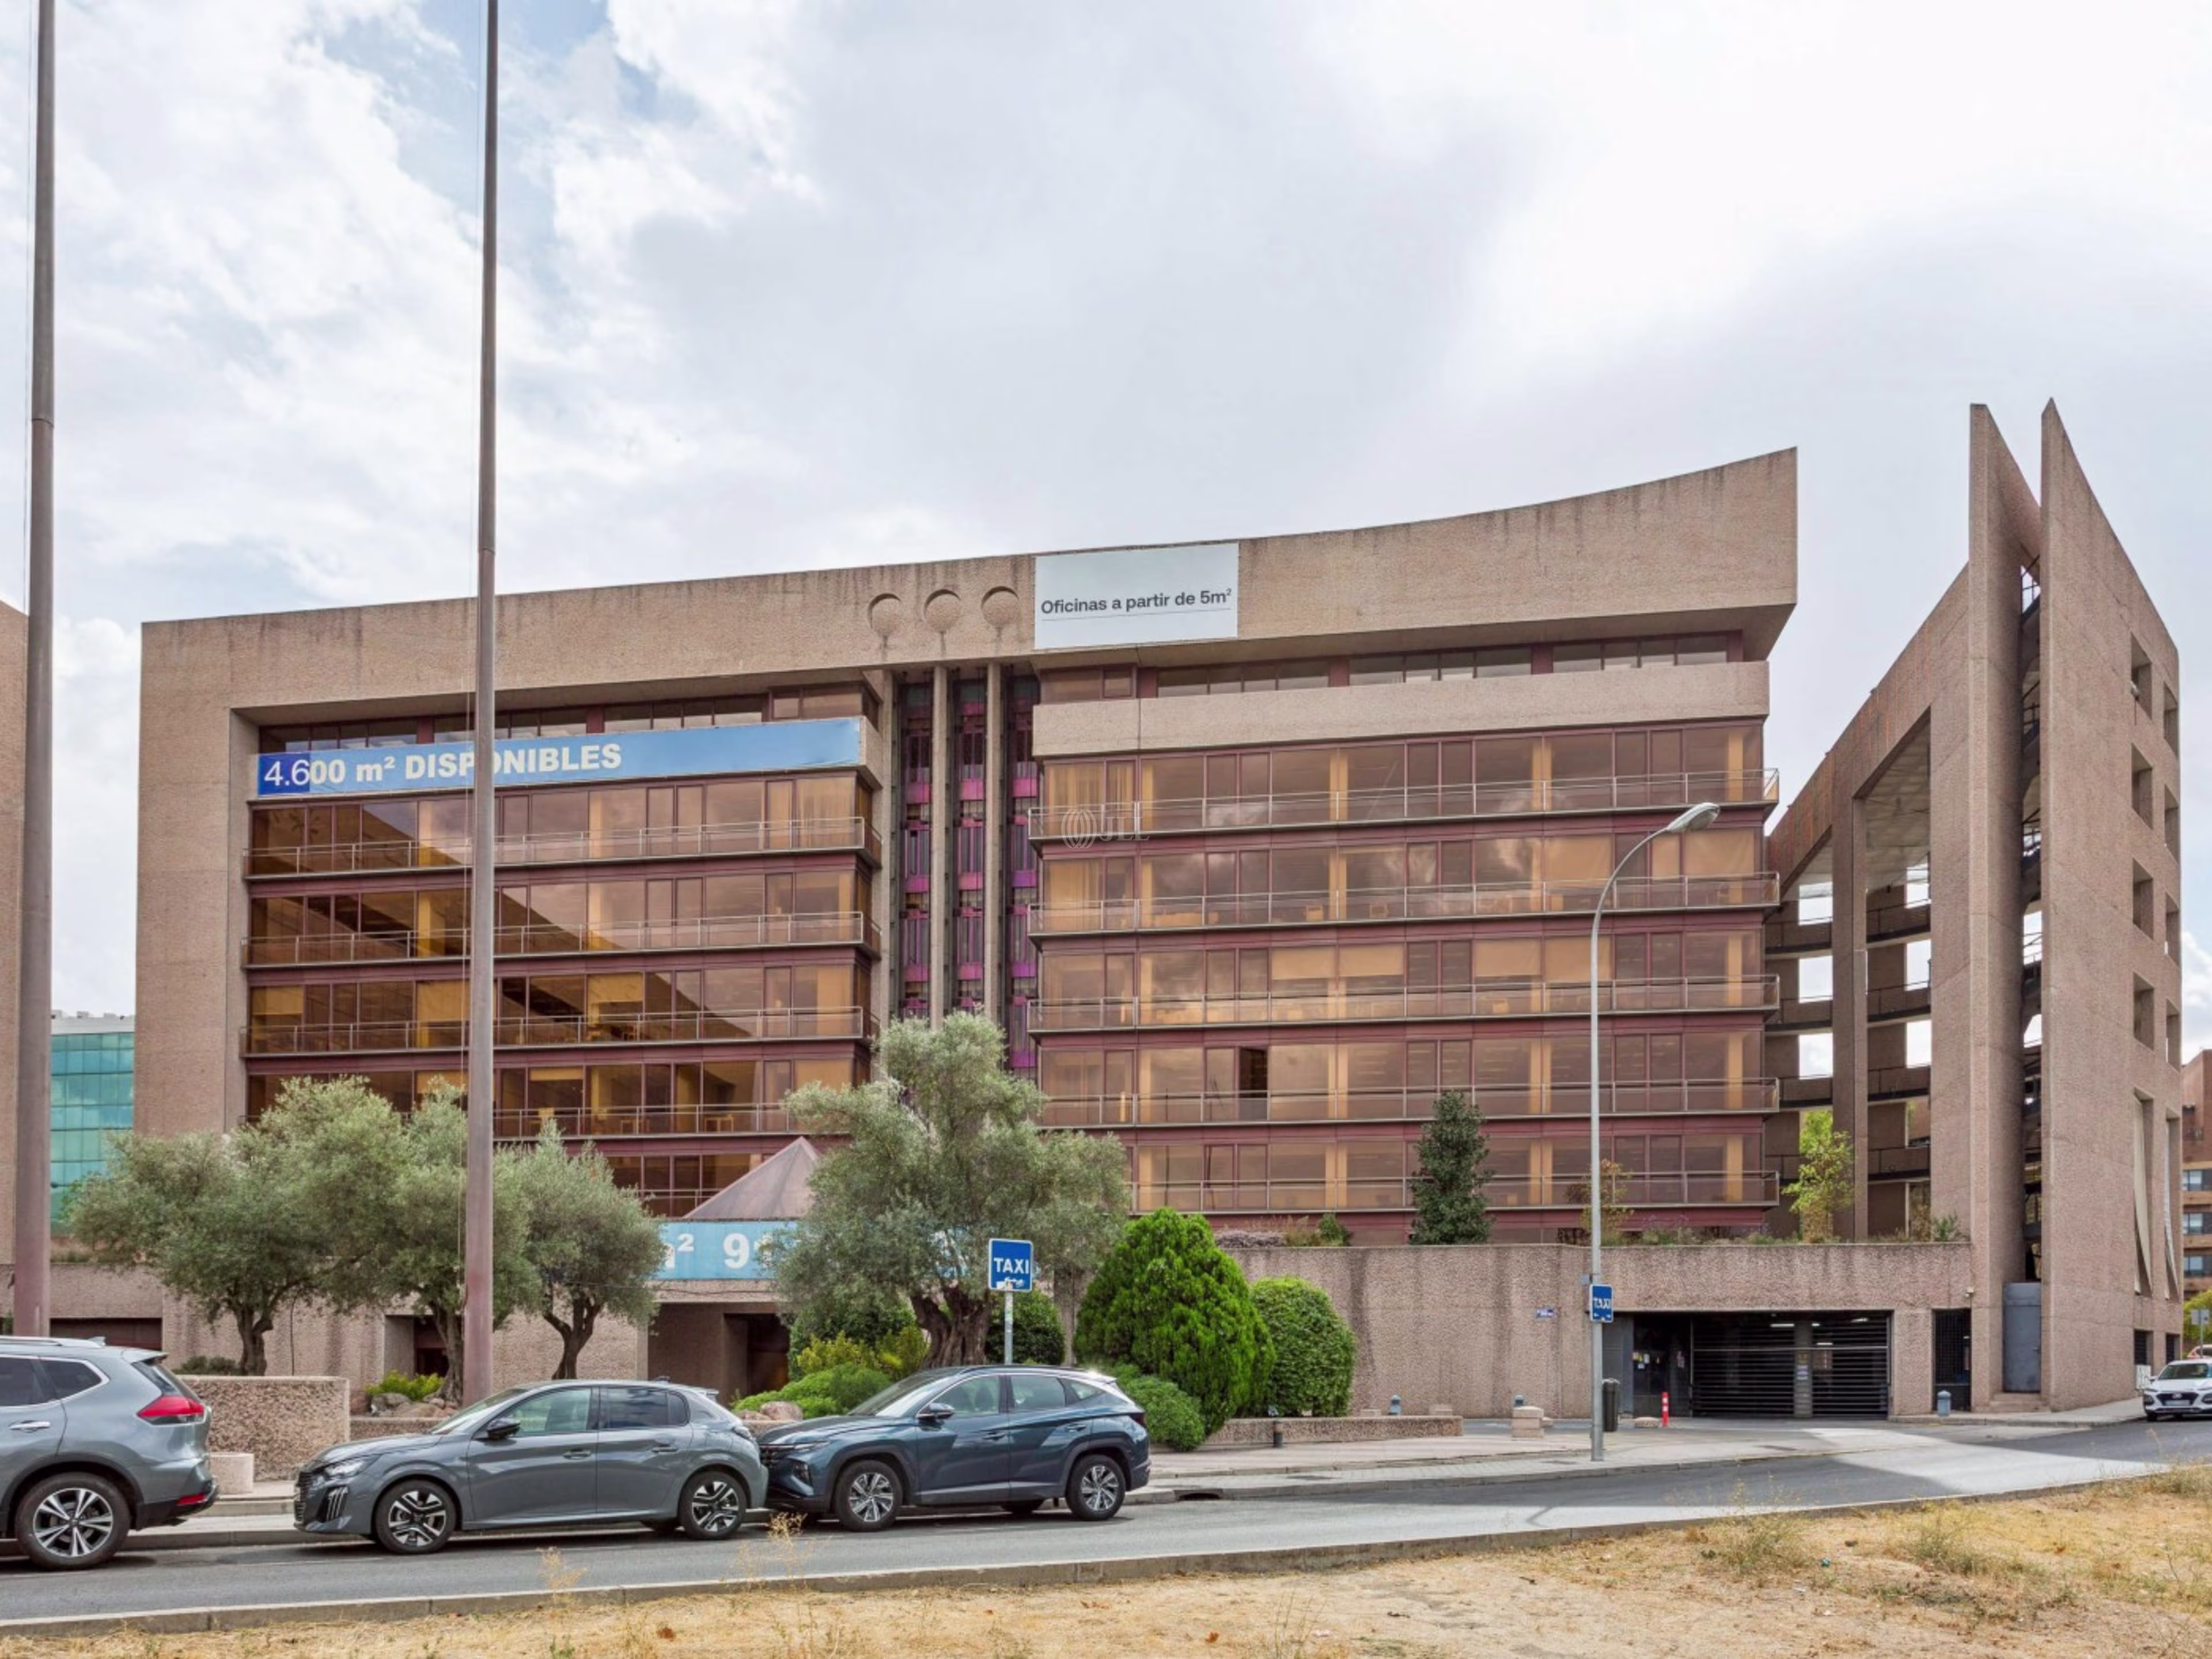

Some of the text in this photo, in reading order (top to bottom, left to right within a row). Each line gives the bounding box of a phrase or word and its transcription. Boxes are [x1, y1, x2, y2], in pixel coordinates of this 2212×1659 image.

[1041, 599, 1108, 615] Oficinas
[1111, 597, 1122, 609] a
[1126, 593, 1171, 612] partir
[1174, 592, 1196, 606] de
[263, 759, 346, 786] 4.600
[356, 757, 395, 781] m²
[993, 1257, 1029, 1275] TAXI
[1593, 1298, 1611, 1309] TAXI
